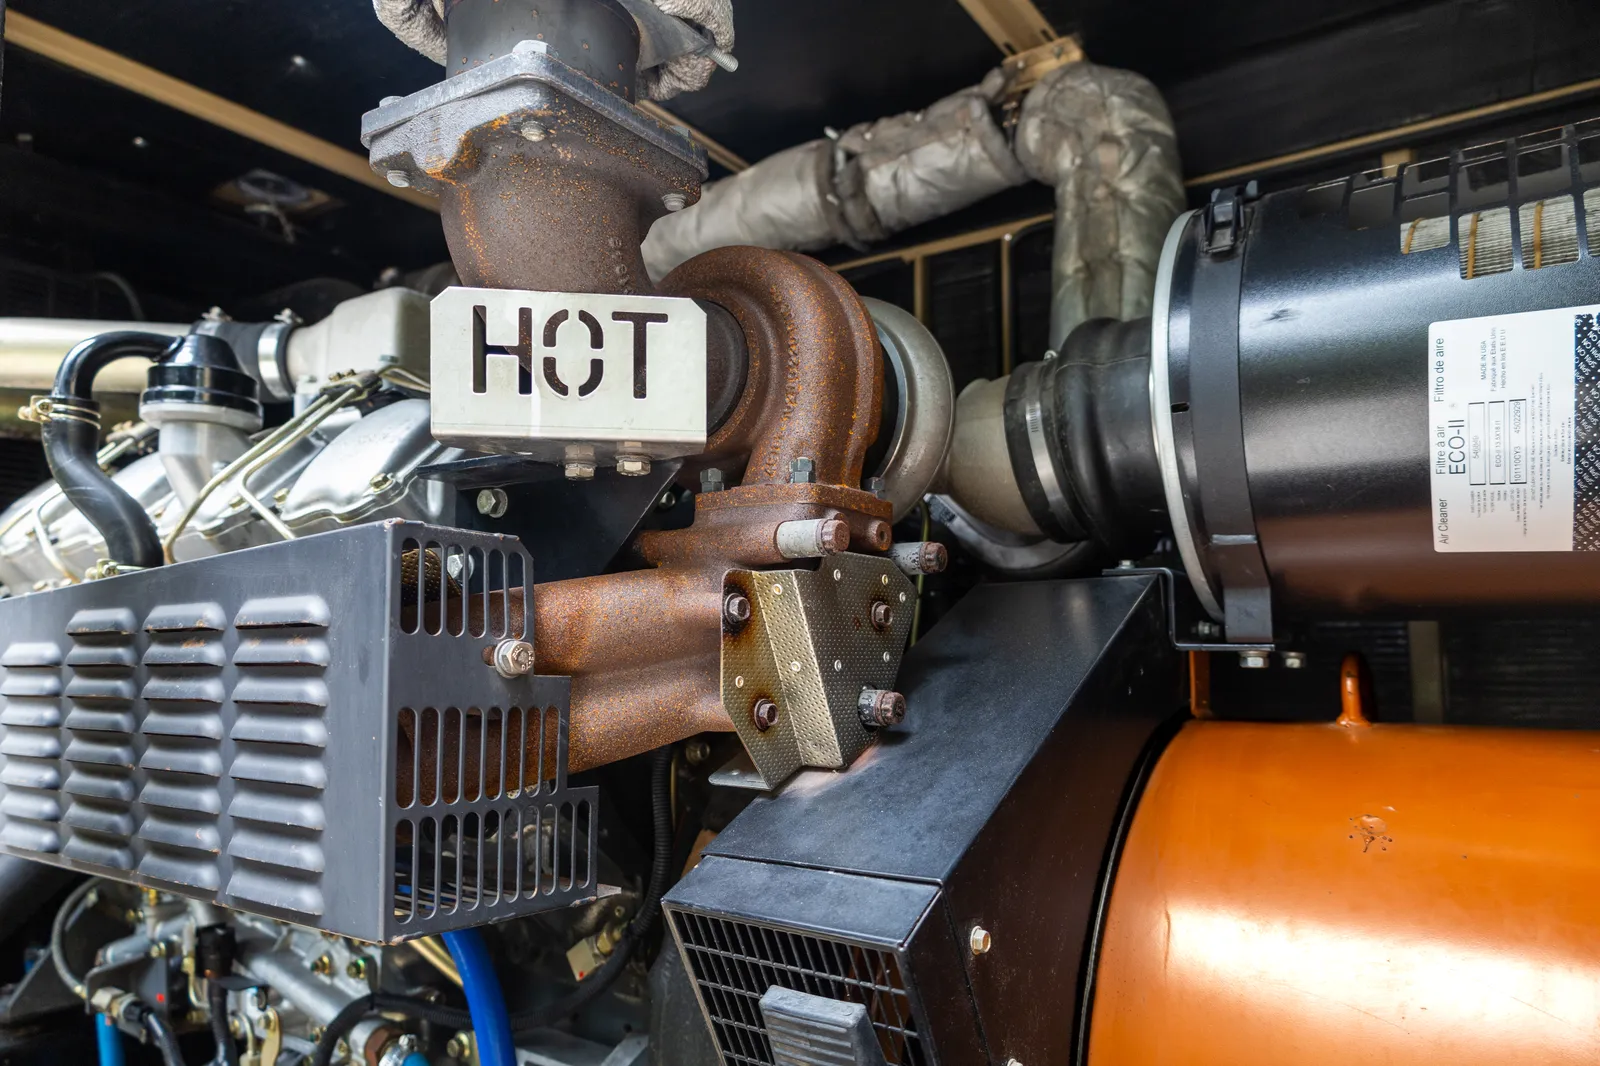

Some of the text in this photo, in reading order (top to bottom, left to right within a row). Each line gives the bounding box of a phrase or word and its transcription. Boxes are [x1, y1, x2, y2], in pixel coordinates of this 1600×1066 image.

[472, 304, 669, 400] HOT
[1433, 338, 1445, 403] Filtro de aire
[1480, 362, 1488, 380] MADE
[1435, 425, 1446, 475] Filtre à air
[1448, 419, 1466, 475] ECO-II
[1437, 498, 1449, 545] Air Cleaner
